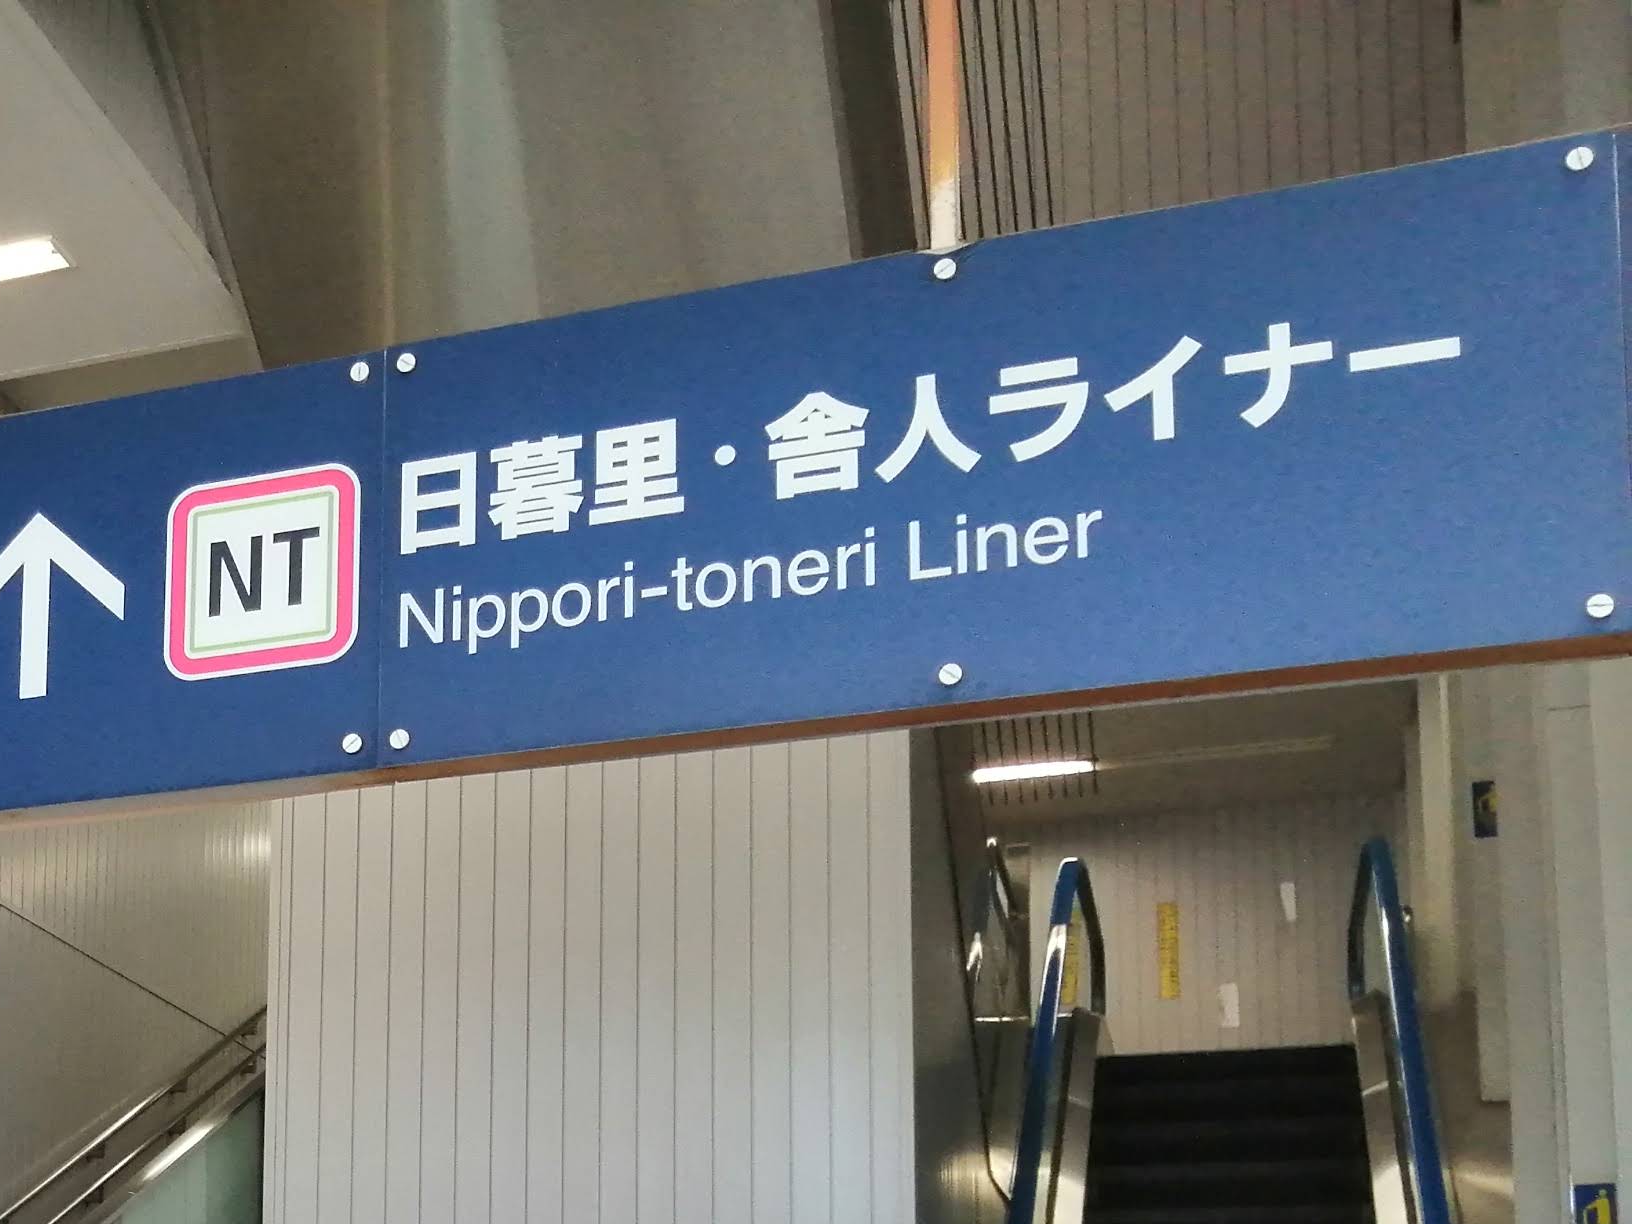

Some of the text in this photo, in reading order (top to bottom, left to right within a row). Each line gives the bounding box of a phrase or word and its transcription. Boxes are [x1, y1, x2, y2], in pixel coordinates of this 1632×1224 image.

[398, 321, 1463, 556] 日暮里・舎人ライナー
[206, 526, 322, 619] NT
[398, 506, 1105, 655] Nippori-toneri Liner
